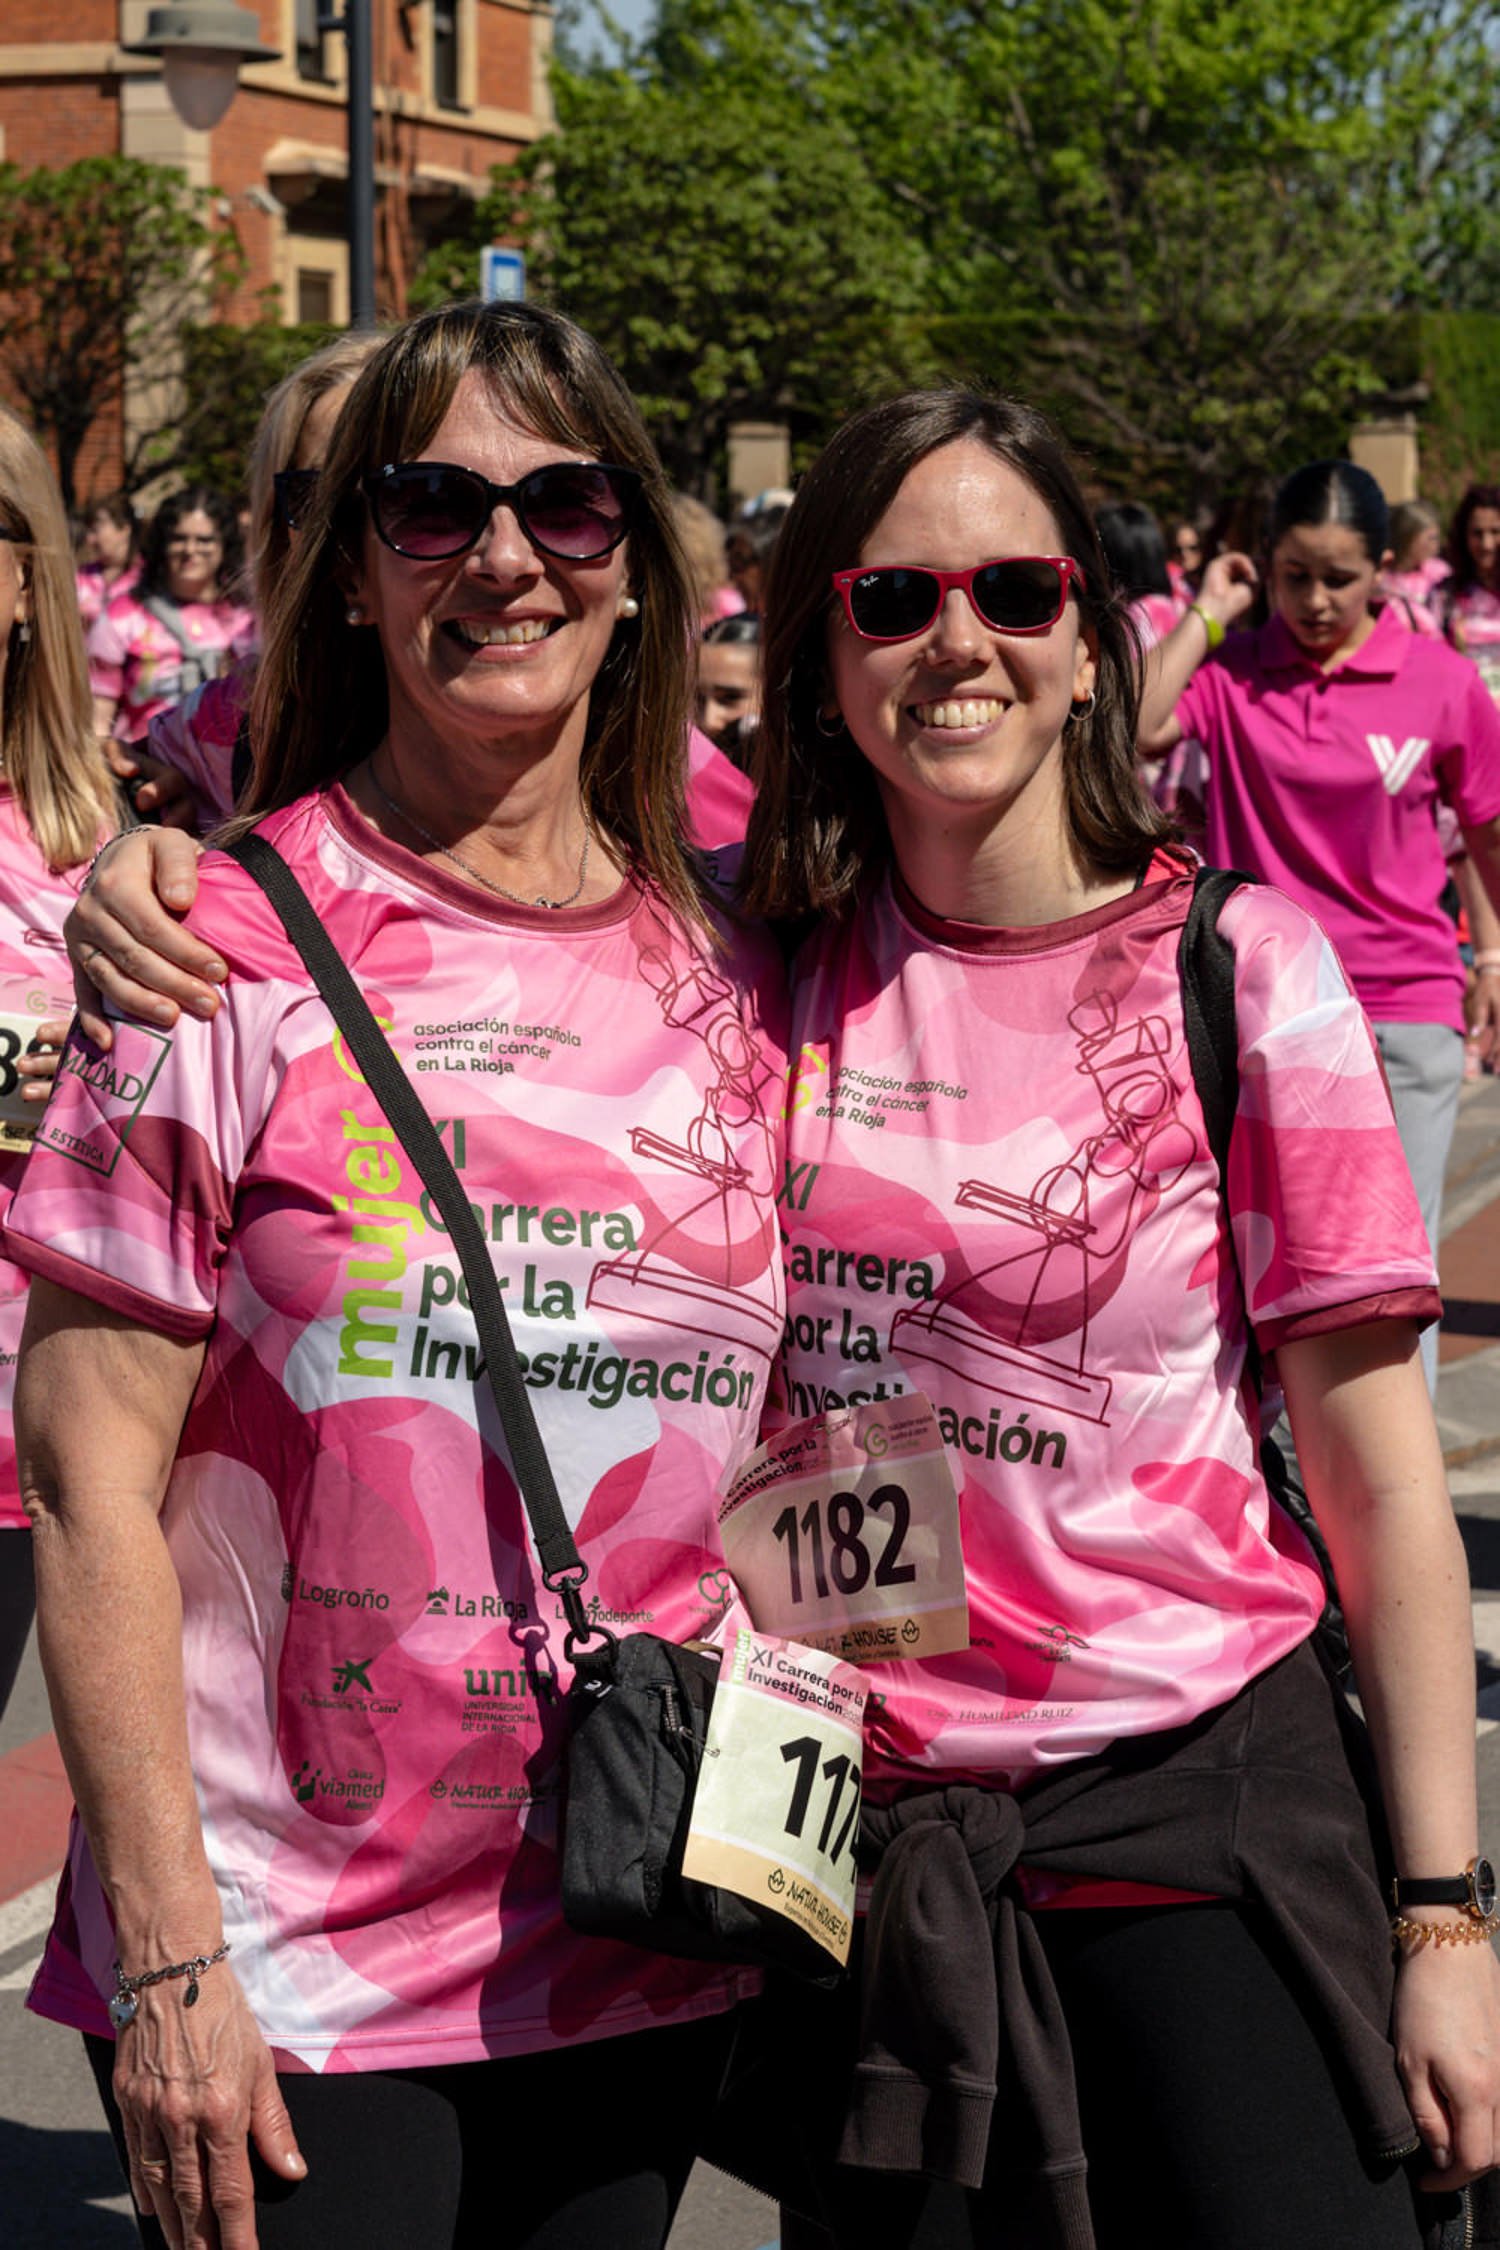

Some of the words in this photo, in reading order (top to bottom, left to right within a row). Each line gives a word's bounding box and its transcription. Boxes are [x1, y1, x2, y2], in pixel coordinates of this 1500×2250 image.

[413, 1016, 510, 1037] asociación
[513, 1024, 582, 1047] española
[414, 1036, 475, 1052] contra
[479, 1038, 493, 1054] el
[497, 1041, 553, 1063] cáncer
[416, 1058, 440, 1072] en
[444, 1056, 466, 1072] La
[470, 1057, 516, 1076] Rioja
[835, 1064, 902, 1093] ociación
[904, 1079, 969, 1101] española
[848, 1107, 888, 1131] Rioja
[866, 1093, 880, 1108] el
[881, 1095, 931, 1114] cáncer
[432, 1118, 467, 1170] I
[776, 1159, 821, 1212] XI
[331, 1109, 426, 1379] mujer
[522, 1264, 577, 1320] la
[838, 1307, 882, 1364] la
[779, 1444, 804, 1461] por
[772, 1484, 916, 1605] 1182
[299, 1577, 390, 1611] Logroño
[455, 1594, 476, 1617] La
[481, 1595, 529, 1622] Rioja
[751, 1646, 773, 1669] XI
[776, 1660, 830, 1691] Carrera
[831, 1682, 855, 1701] por
[855, 1691, 863, 1707] la
[461, 1711, 538, 1724] INTERNACIONAL
[461, 1723, 475, 1732] DE
[476, 1724, 488, 1733] LA
[1039, 1707, 1075, 1719] RUIZ
[319, 1777, 385, 1799] viamed
[780, 1736, 862, 1885] 117
